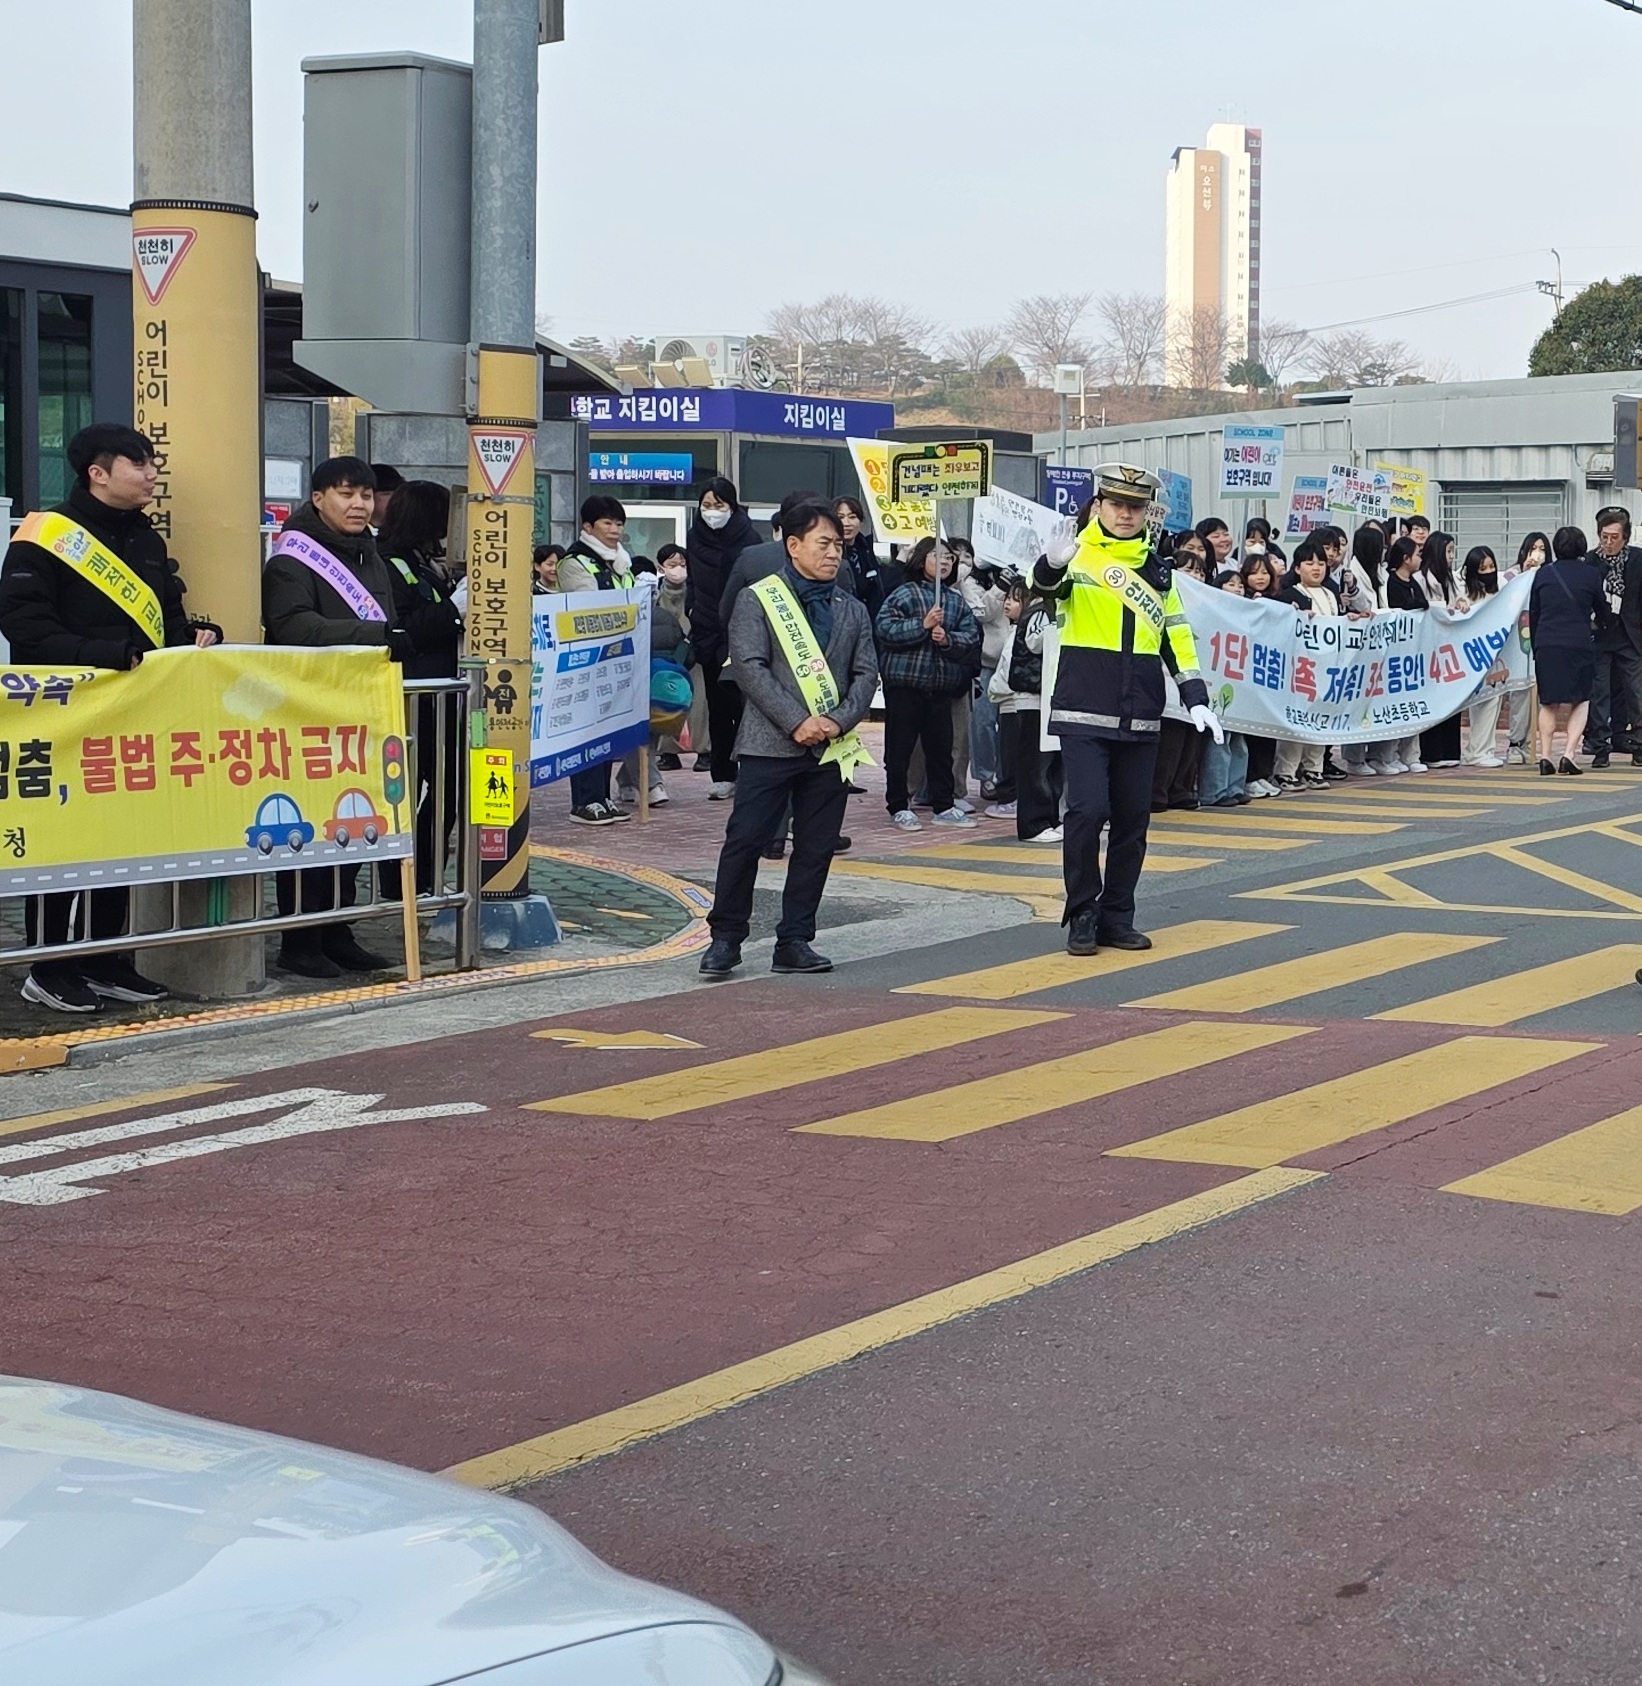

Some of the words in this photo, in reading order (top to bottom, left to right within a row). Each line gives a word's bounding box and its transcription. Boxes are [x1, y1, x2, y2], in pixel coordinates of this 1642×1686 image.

[138, 238, 173, 254] 천천히
[141, 255, 169, 265] SLOW
[145, 320, 168, 407] 어린이
[571, 396, 612, 422] 학교
[618, 396, 700, 422] 지킴이실
[784, 402, 846, 431] 지킴이실
[480, 439, 515, 453] 천천히
[484, 453, 511, 463] SLOW
[1226, 469, 1251, 486] 보호구역
[1055, 487, 1068, 513] P
[485, 510, 508, 569] 어린이
[472, 529, 482, 606] SCHOOL
[1108, 568, 1123, 585] 30
[483, 578, 509, 658] 보호구역
[471, 613, 481, 657] ZON
[1210, 631, 1248, 681] 1단
[1252, 642, 1286, 691] 멈춤!
[1387, 653, 1425, 694] 동안!
[1429, 644, 1466, 683] 4고
[1373, 700, 1431, 724] 노산초등학교
[80, 733, 156, 795] 불법
[169, 727, 292, 788] 주·정차
[301, 724, 368, 780] 금지
[2, 826, 27, 859] 청
